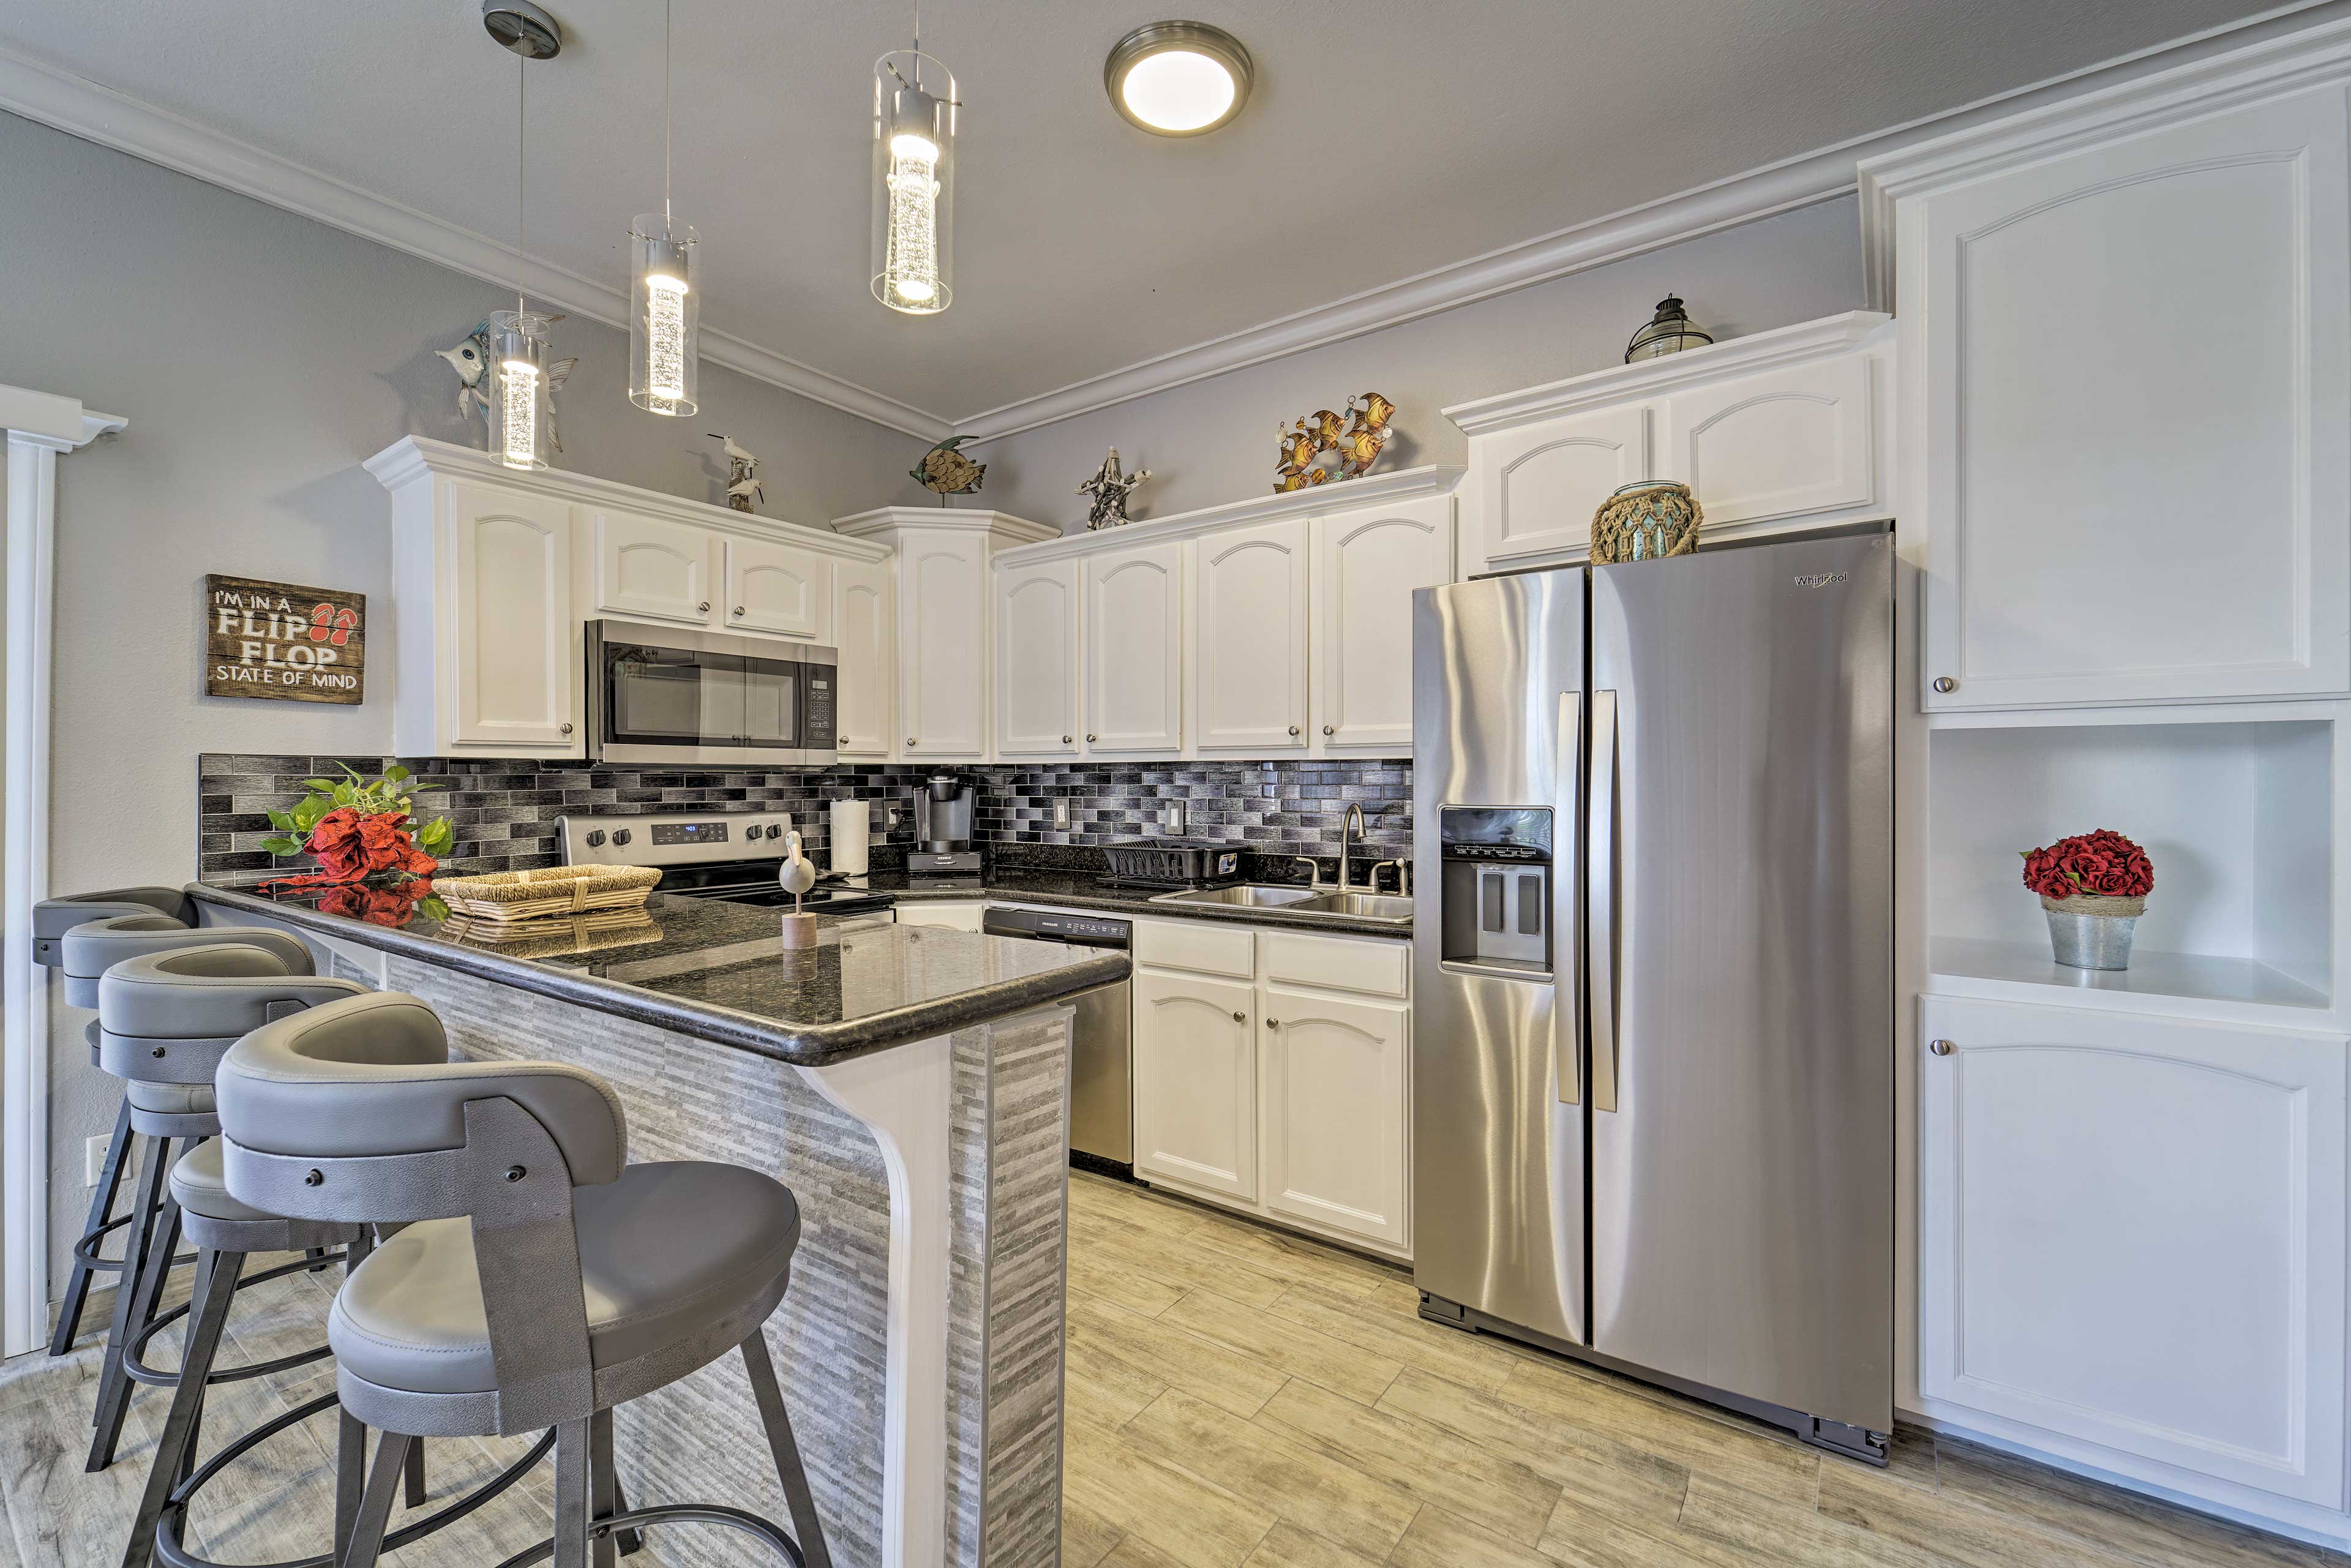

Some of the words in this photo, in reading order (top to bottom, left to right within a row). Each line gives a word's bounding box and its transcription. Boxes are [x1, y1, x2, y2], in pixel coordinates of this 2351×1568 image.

[1794, 572, 1848, 586] Whirlpool
[216, 590, 243, 607] I'M
[251, 596, 269, 610] IN
[277, 598, 291, 613] A
[217, 607, 307, 641] FLIP
[239, 640, 337, 672] FLOP
[217, 666, 274, 683] STATE
[283, 672, 304, 685] OF
[312, 674, 357, 689] MIND
